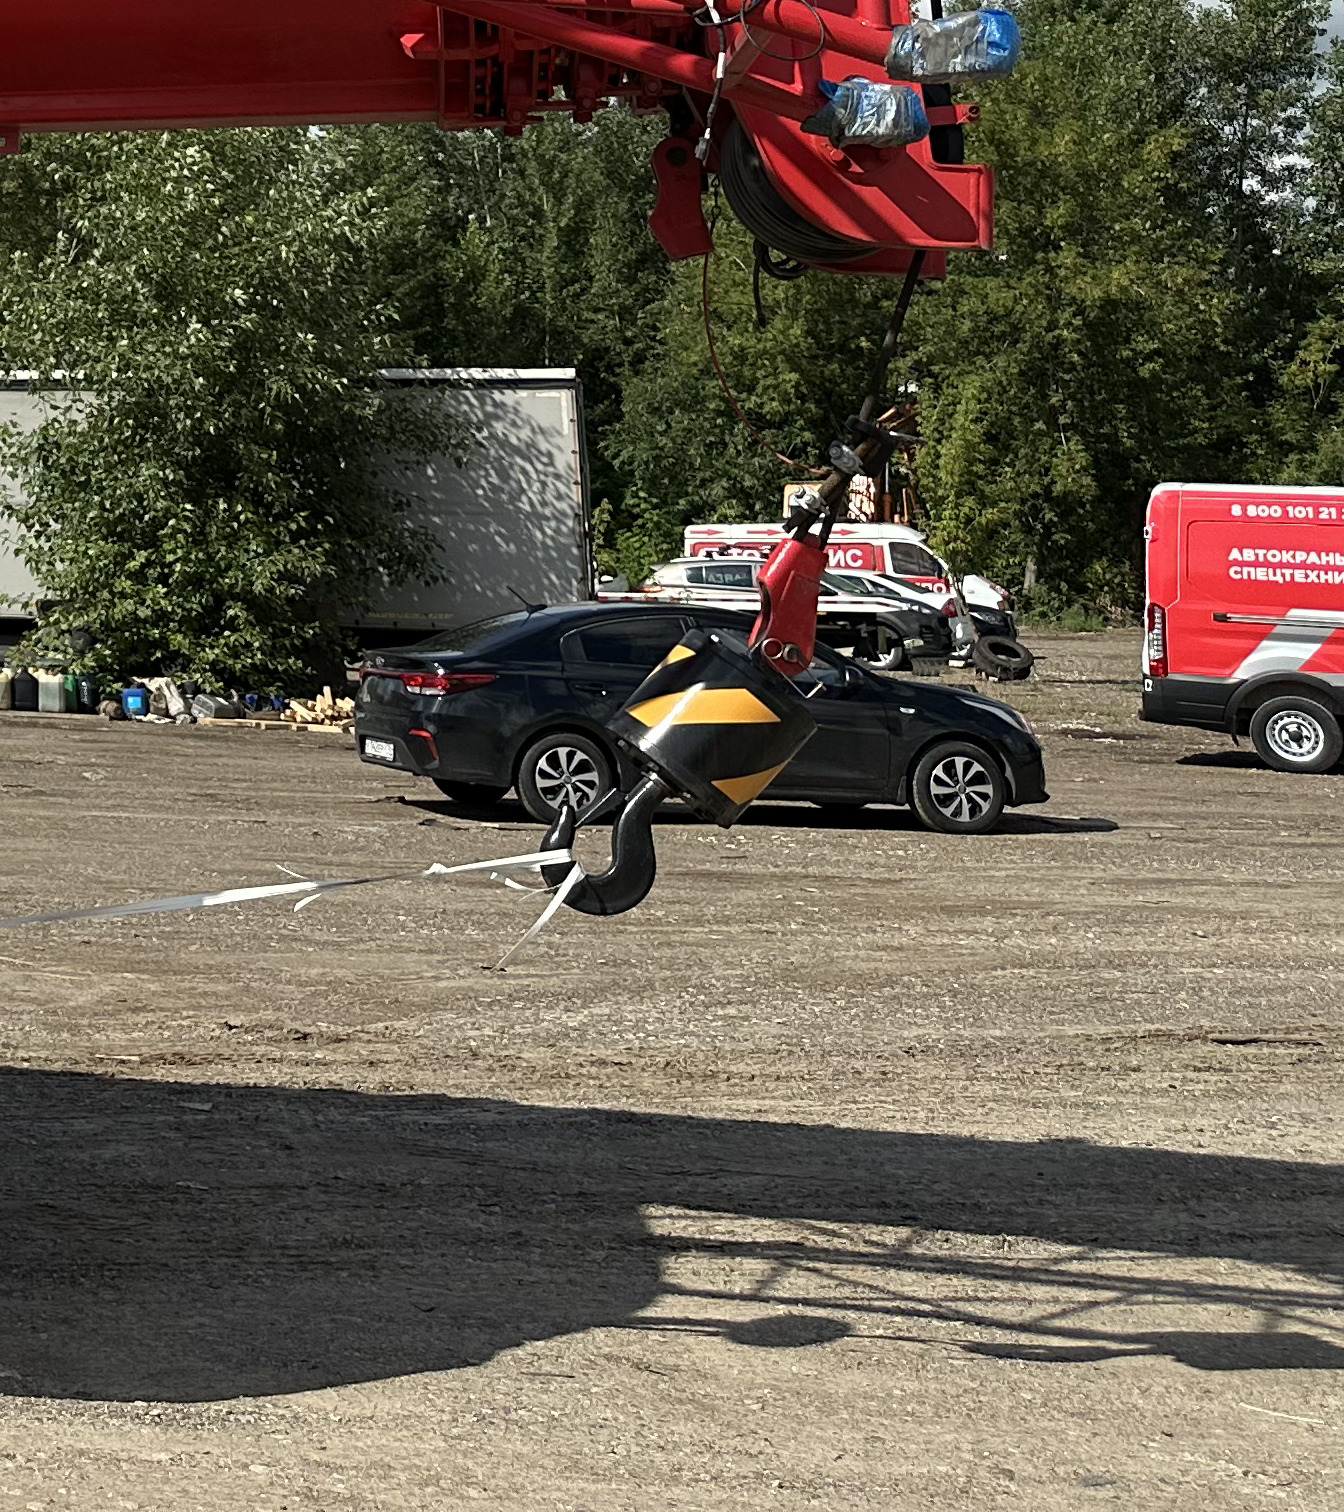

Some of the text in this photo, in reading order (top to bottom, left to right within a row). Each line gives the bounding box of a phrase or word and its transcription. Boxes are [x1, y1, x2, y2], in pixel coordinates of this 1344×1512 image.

[1231, 504, 1242, 516] 8
[1246, 504, 1282, 518] 800
[1286, 506, 1314, 519] 101
[1318, 507, 1337, 519] 21
